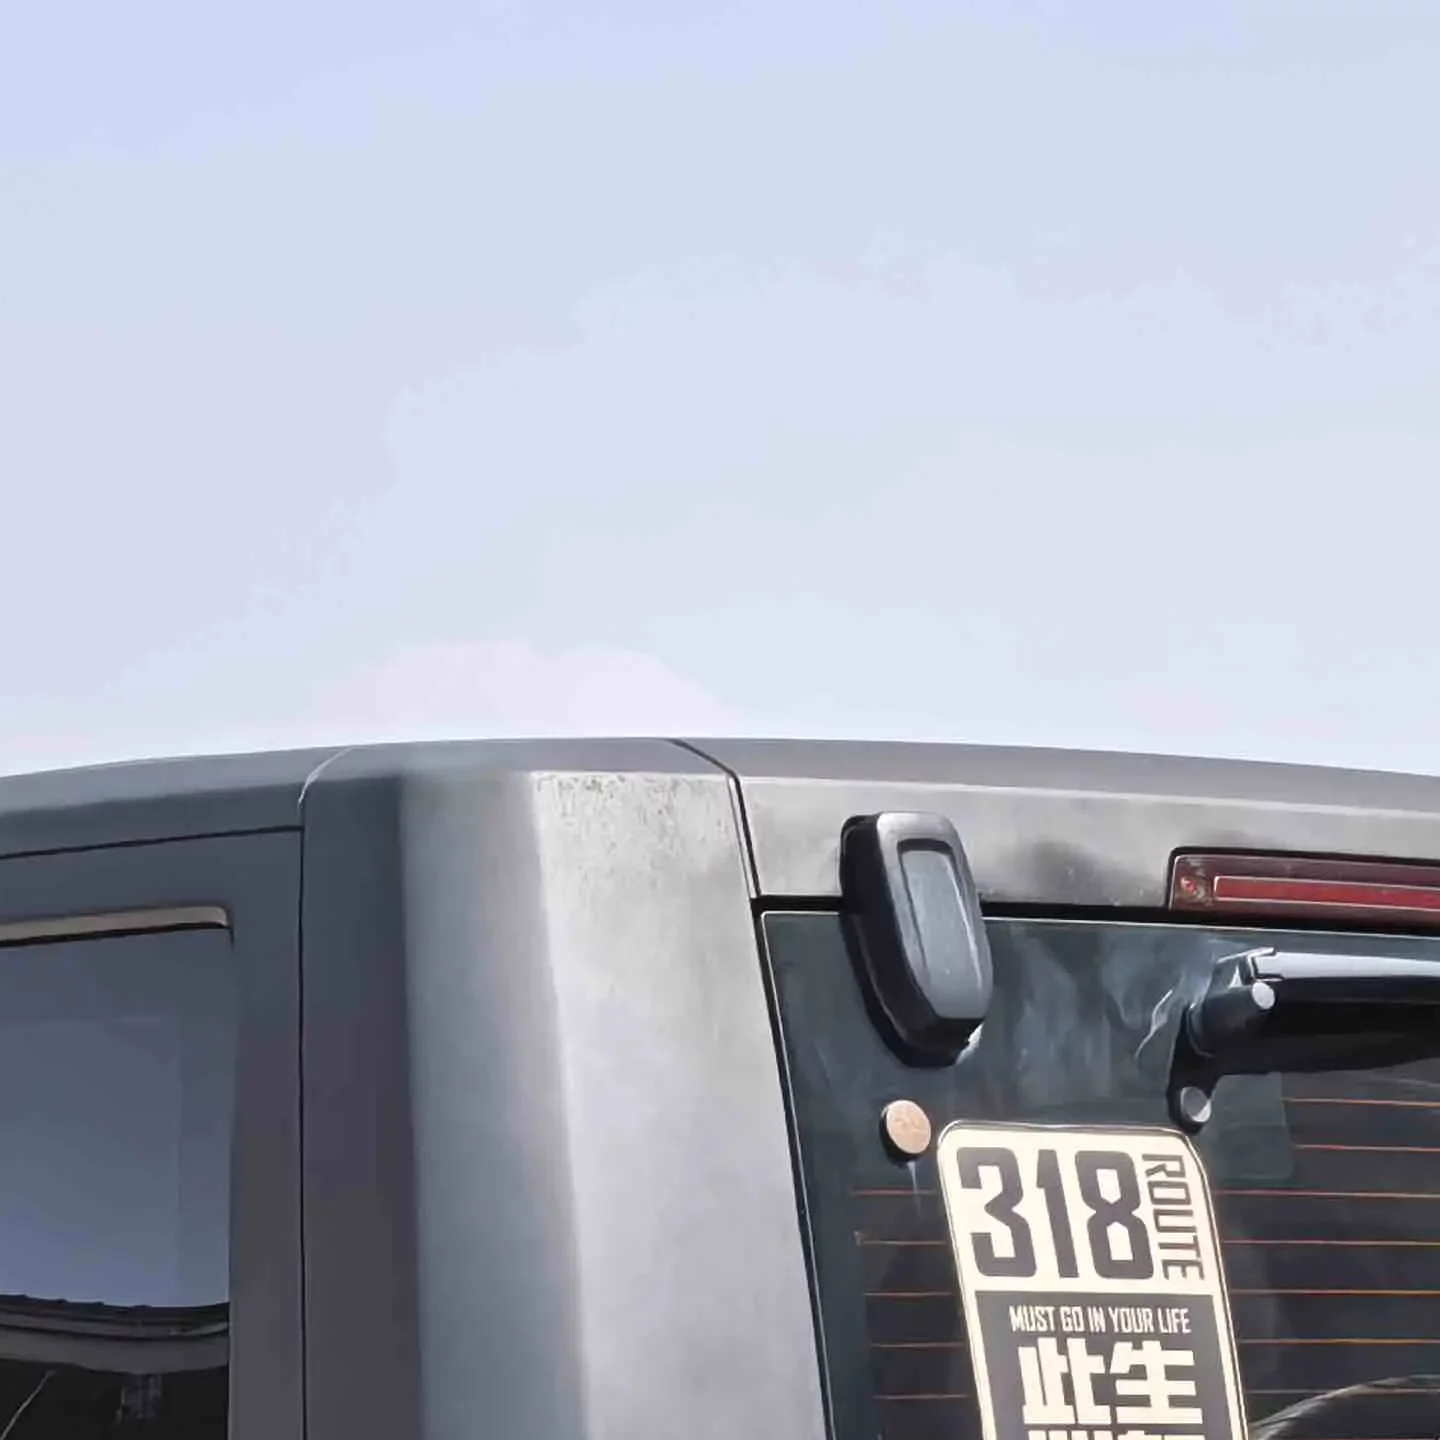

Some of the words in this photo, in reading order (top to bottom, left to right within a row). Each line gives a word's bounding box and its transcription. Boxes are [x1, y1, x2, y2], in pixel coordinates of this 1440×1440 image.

[955, 1146, 1155, 1280] 318
[1141, 1153, 1205, 1282] ROUTE
[1008, 1305, 1056, 1333] MUST
[1059, 1305, 1085, 1333] GO
[1087, 1306, 1106, 1333] IN
[1107, 1307, 1154, 1334] YOUR
[1157, 1307, 1192, 1334] LIFE
[1017, 1338, 1203, 1425] 此生
